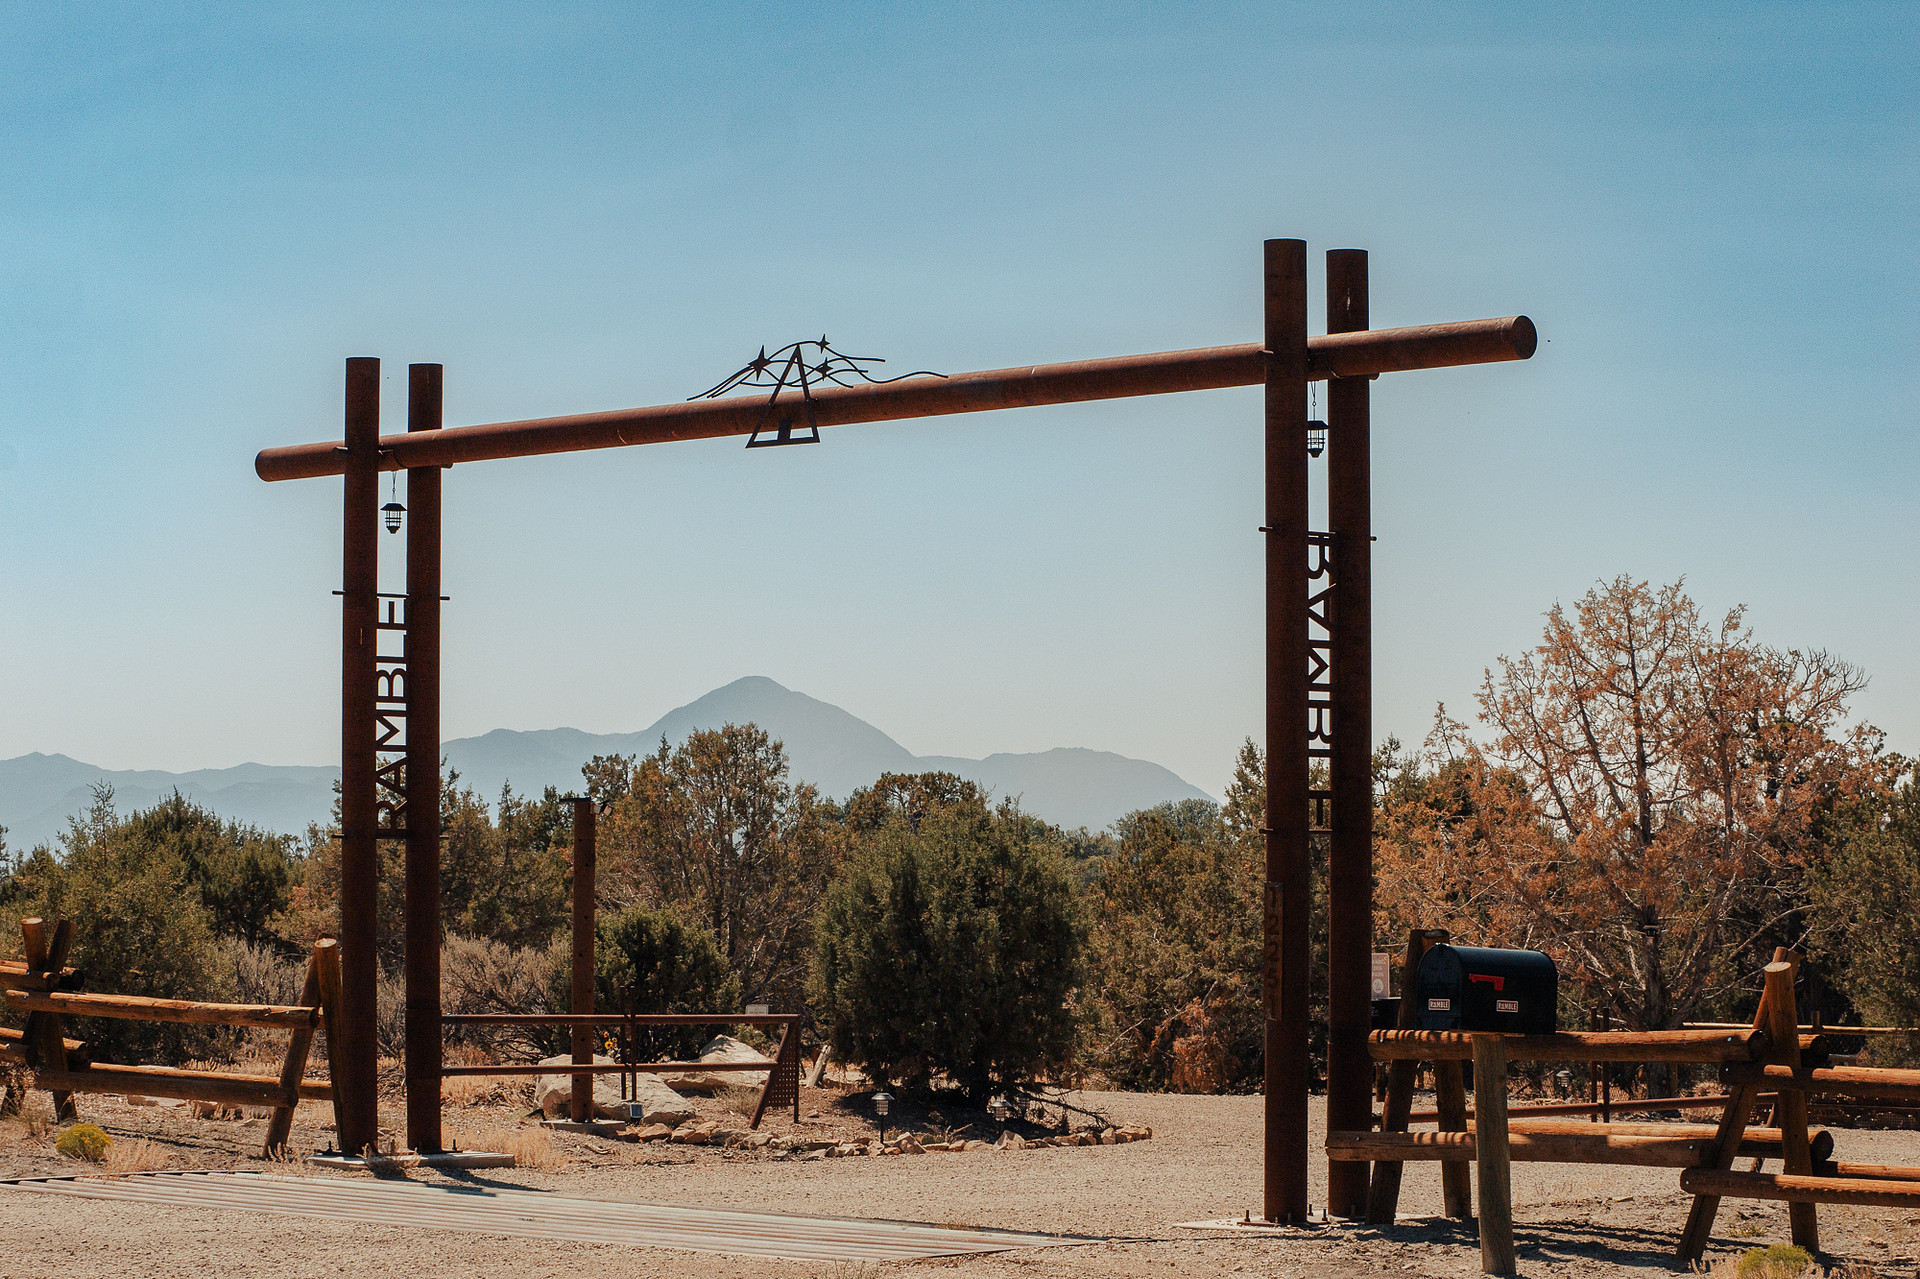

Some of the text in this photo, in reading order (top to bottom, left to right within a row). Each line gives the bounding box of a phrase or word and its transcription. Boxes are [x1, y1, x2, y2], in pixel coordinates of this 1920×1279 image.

[375, 597, 409, 838] RAMBLE
[1430, 1000, 1449, 1008] RAMBLE
[1498, 1002, 1517, 1010] RAMBLE
